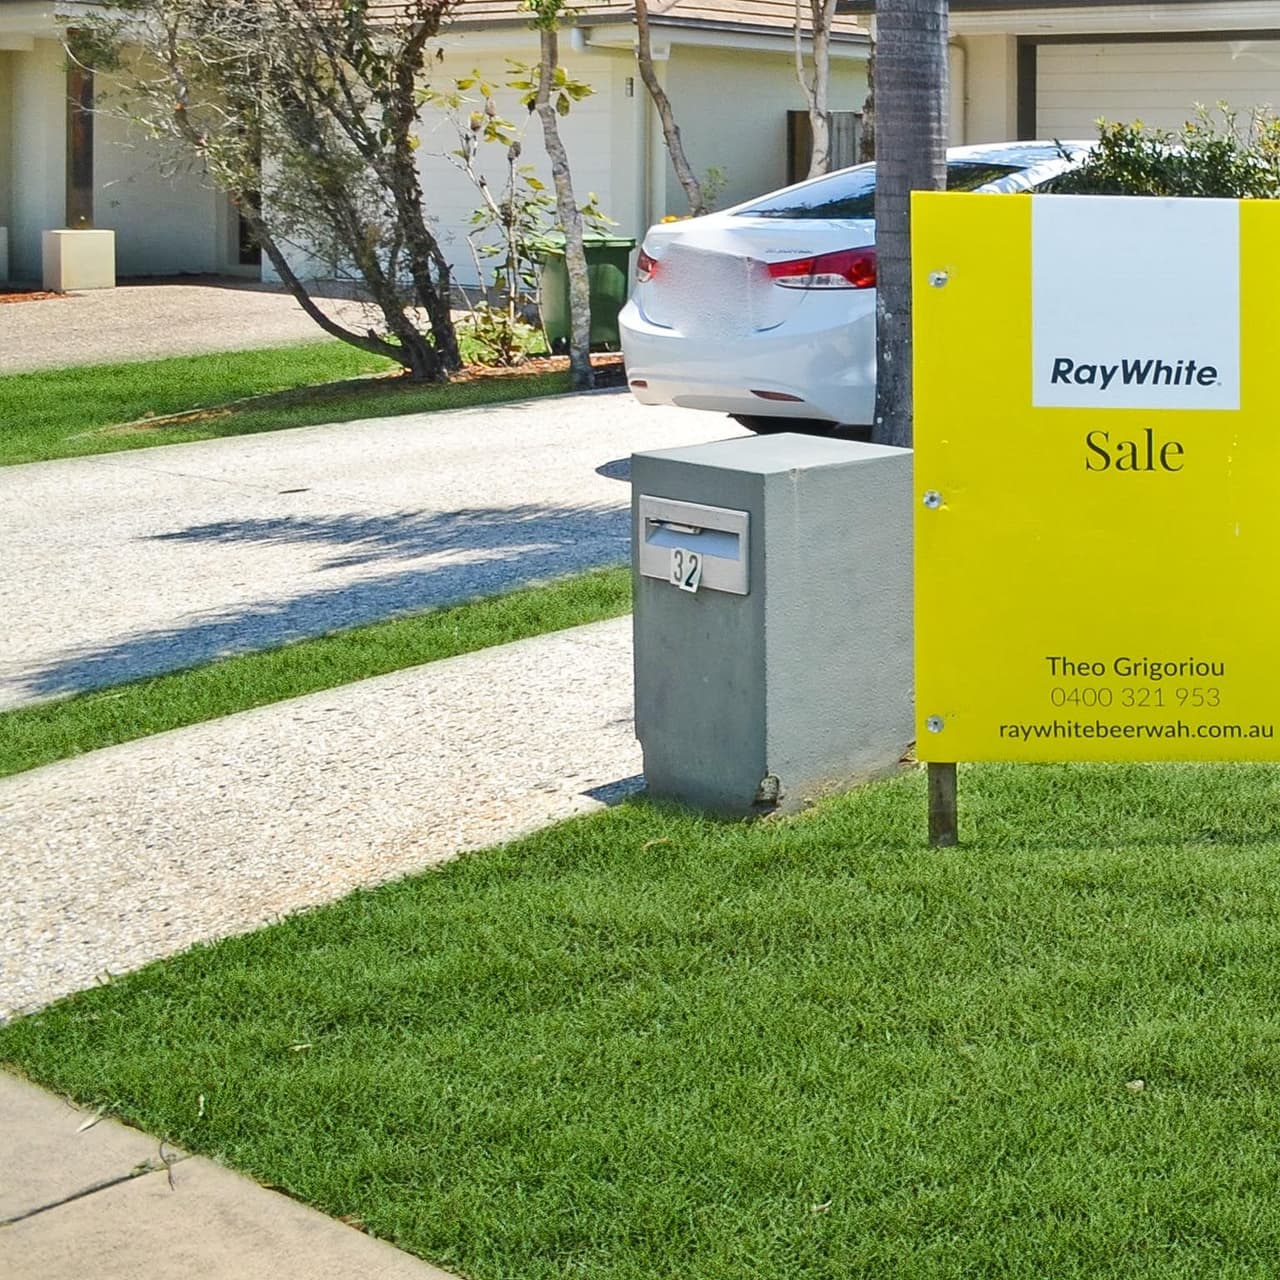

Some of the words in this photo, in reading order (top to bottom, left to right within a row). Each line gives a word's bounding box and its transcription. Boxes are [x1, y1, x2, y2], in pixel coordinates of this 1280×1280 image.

[1085, 428, 1185, 471] Sale
[674, 550, 698, 588] 32
[1045, 656, 1106, 676] Theo
[1113, 656, 1225, 681] Grigoriou
[1050, 687, 1113, 707] 0400
[1121, 687, 1165, 707] 321
[1175, 687, 1221, 707] 953
[999, 720, 1274, 741] raywhitebeerwah.com.au
